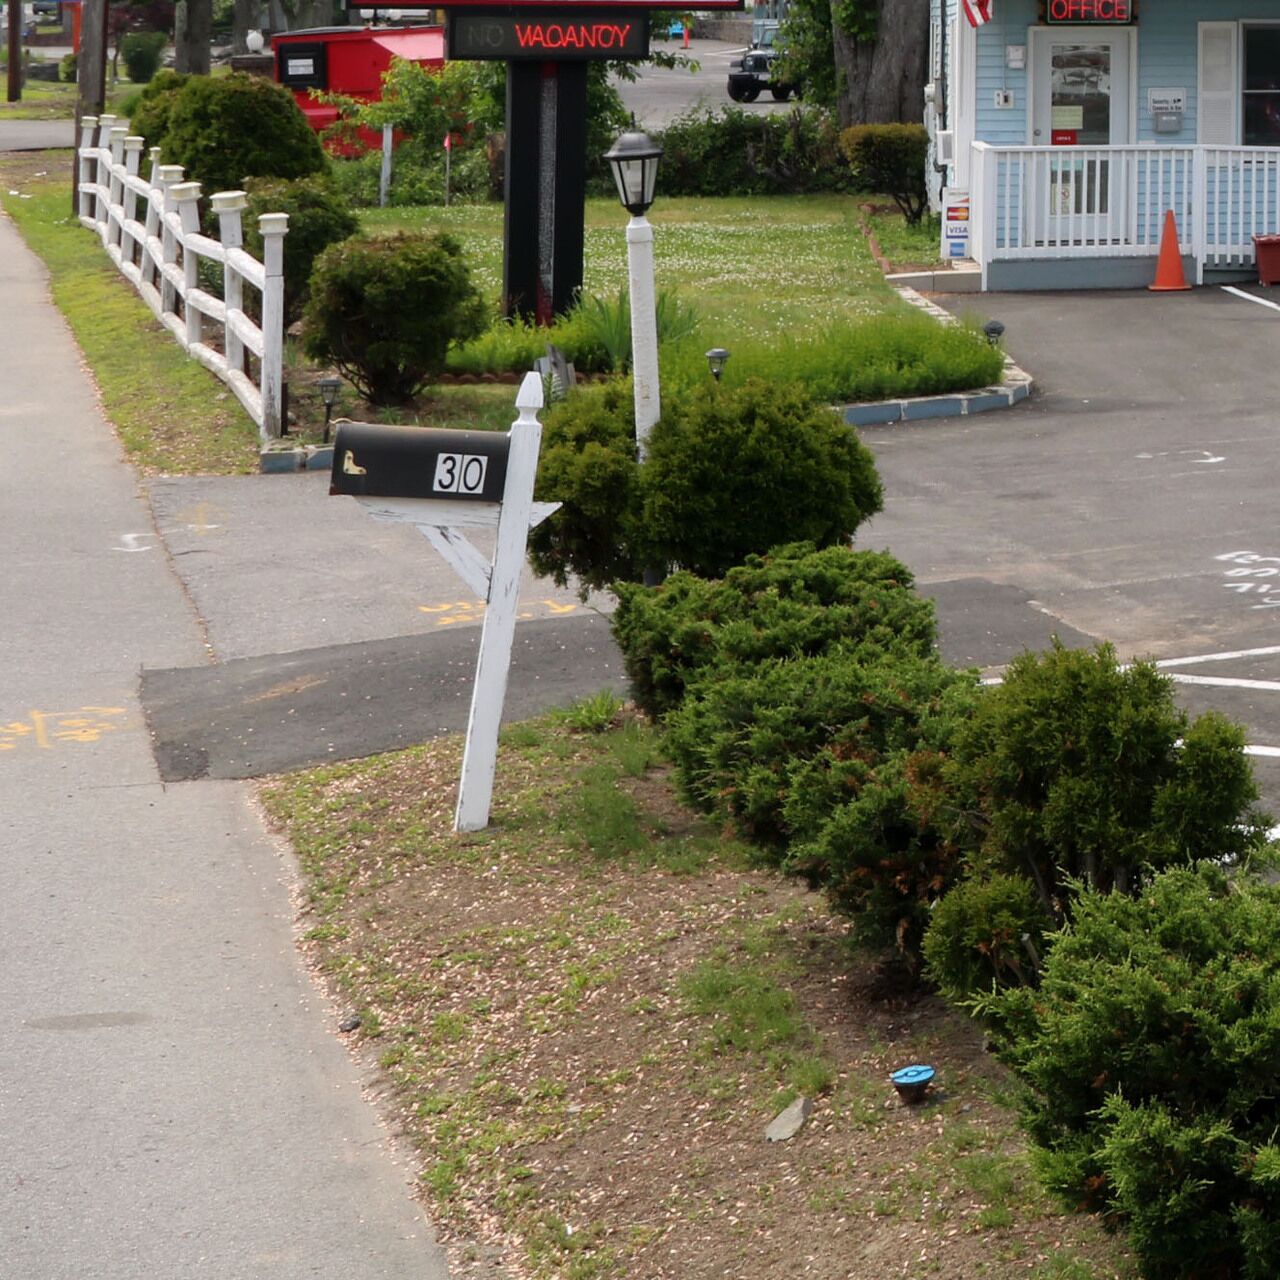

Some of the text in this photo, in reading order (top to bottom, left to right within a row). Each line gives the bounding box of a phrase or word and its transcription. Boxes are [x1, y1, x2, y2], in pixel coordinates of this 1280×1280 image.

[514, 23, 631, 49] VACANCY
[949, 226, 968, 234] VISA
[438, 455, 483, 491] 30
